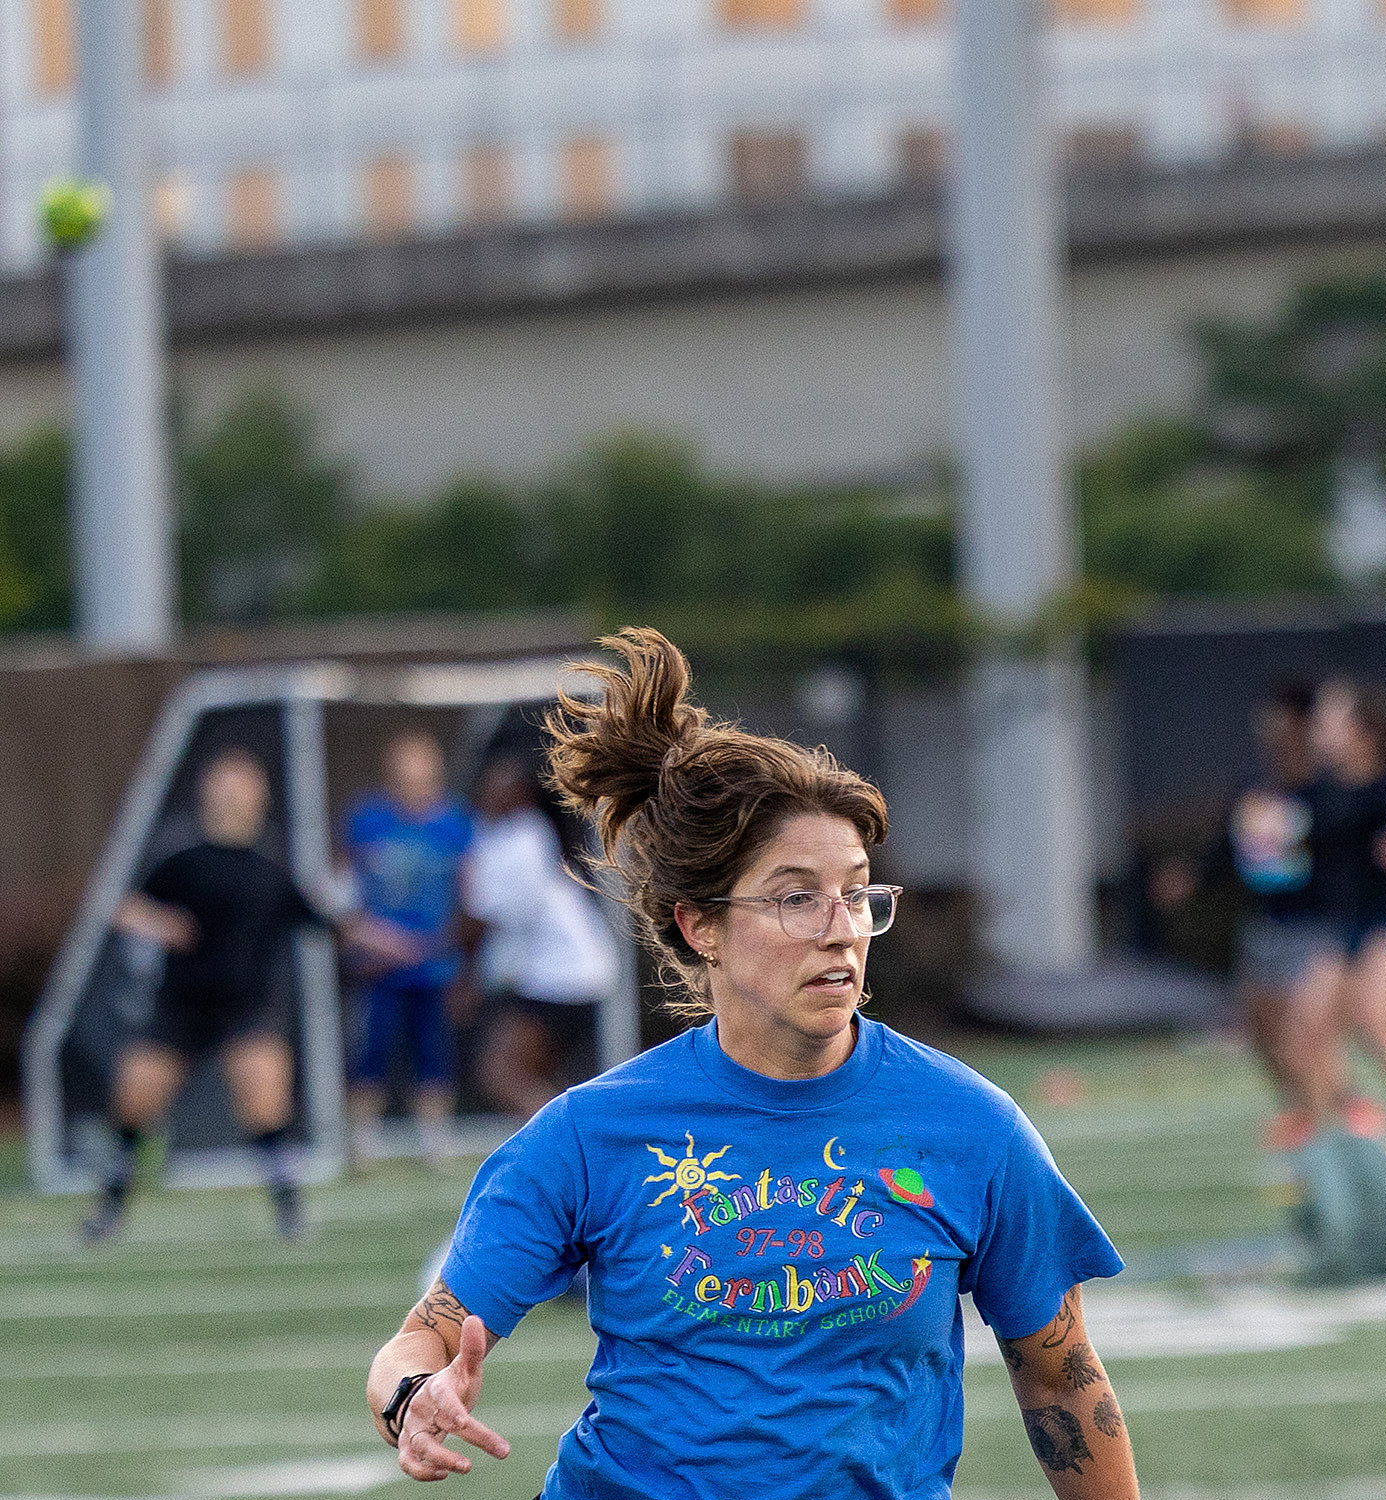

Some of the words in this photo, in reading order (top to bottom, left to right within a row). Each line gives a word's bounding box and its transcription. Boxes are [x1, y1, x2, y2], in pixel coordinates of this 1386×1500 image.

[681, 1167, 885, 1239] Fantastic
[736, 1226, 826, 1259] 97-98
[661, 1289, 810, 1338] ELEMENTARY
[820, 1296, 902, 1330] SCHOOL
